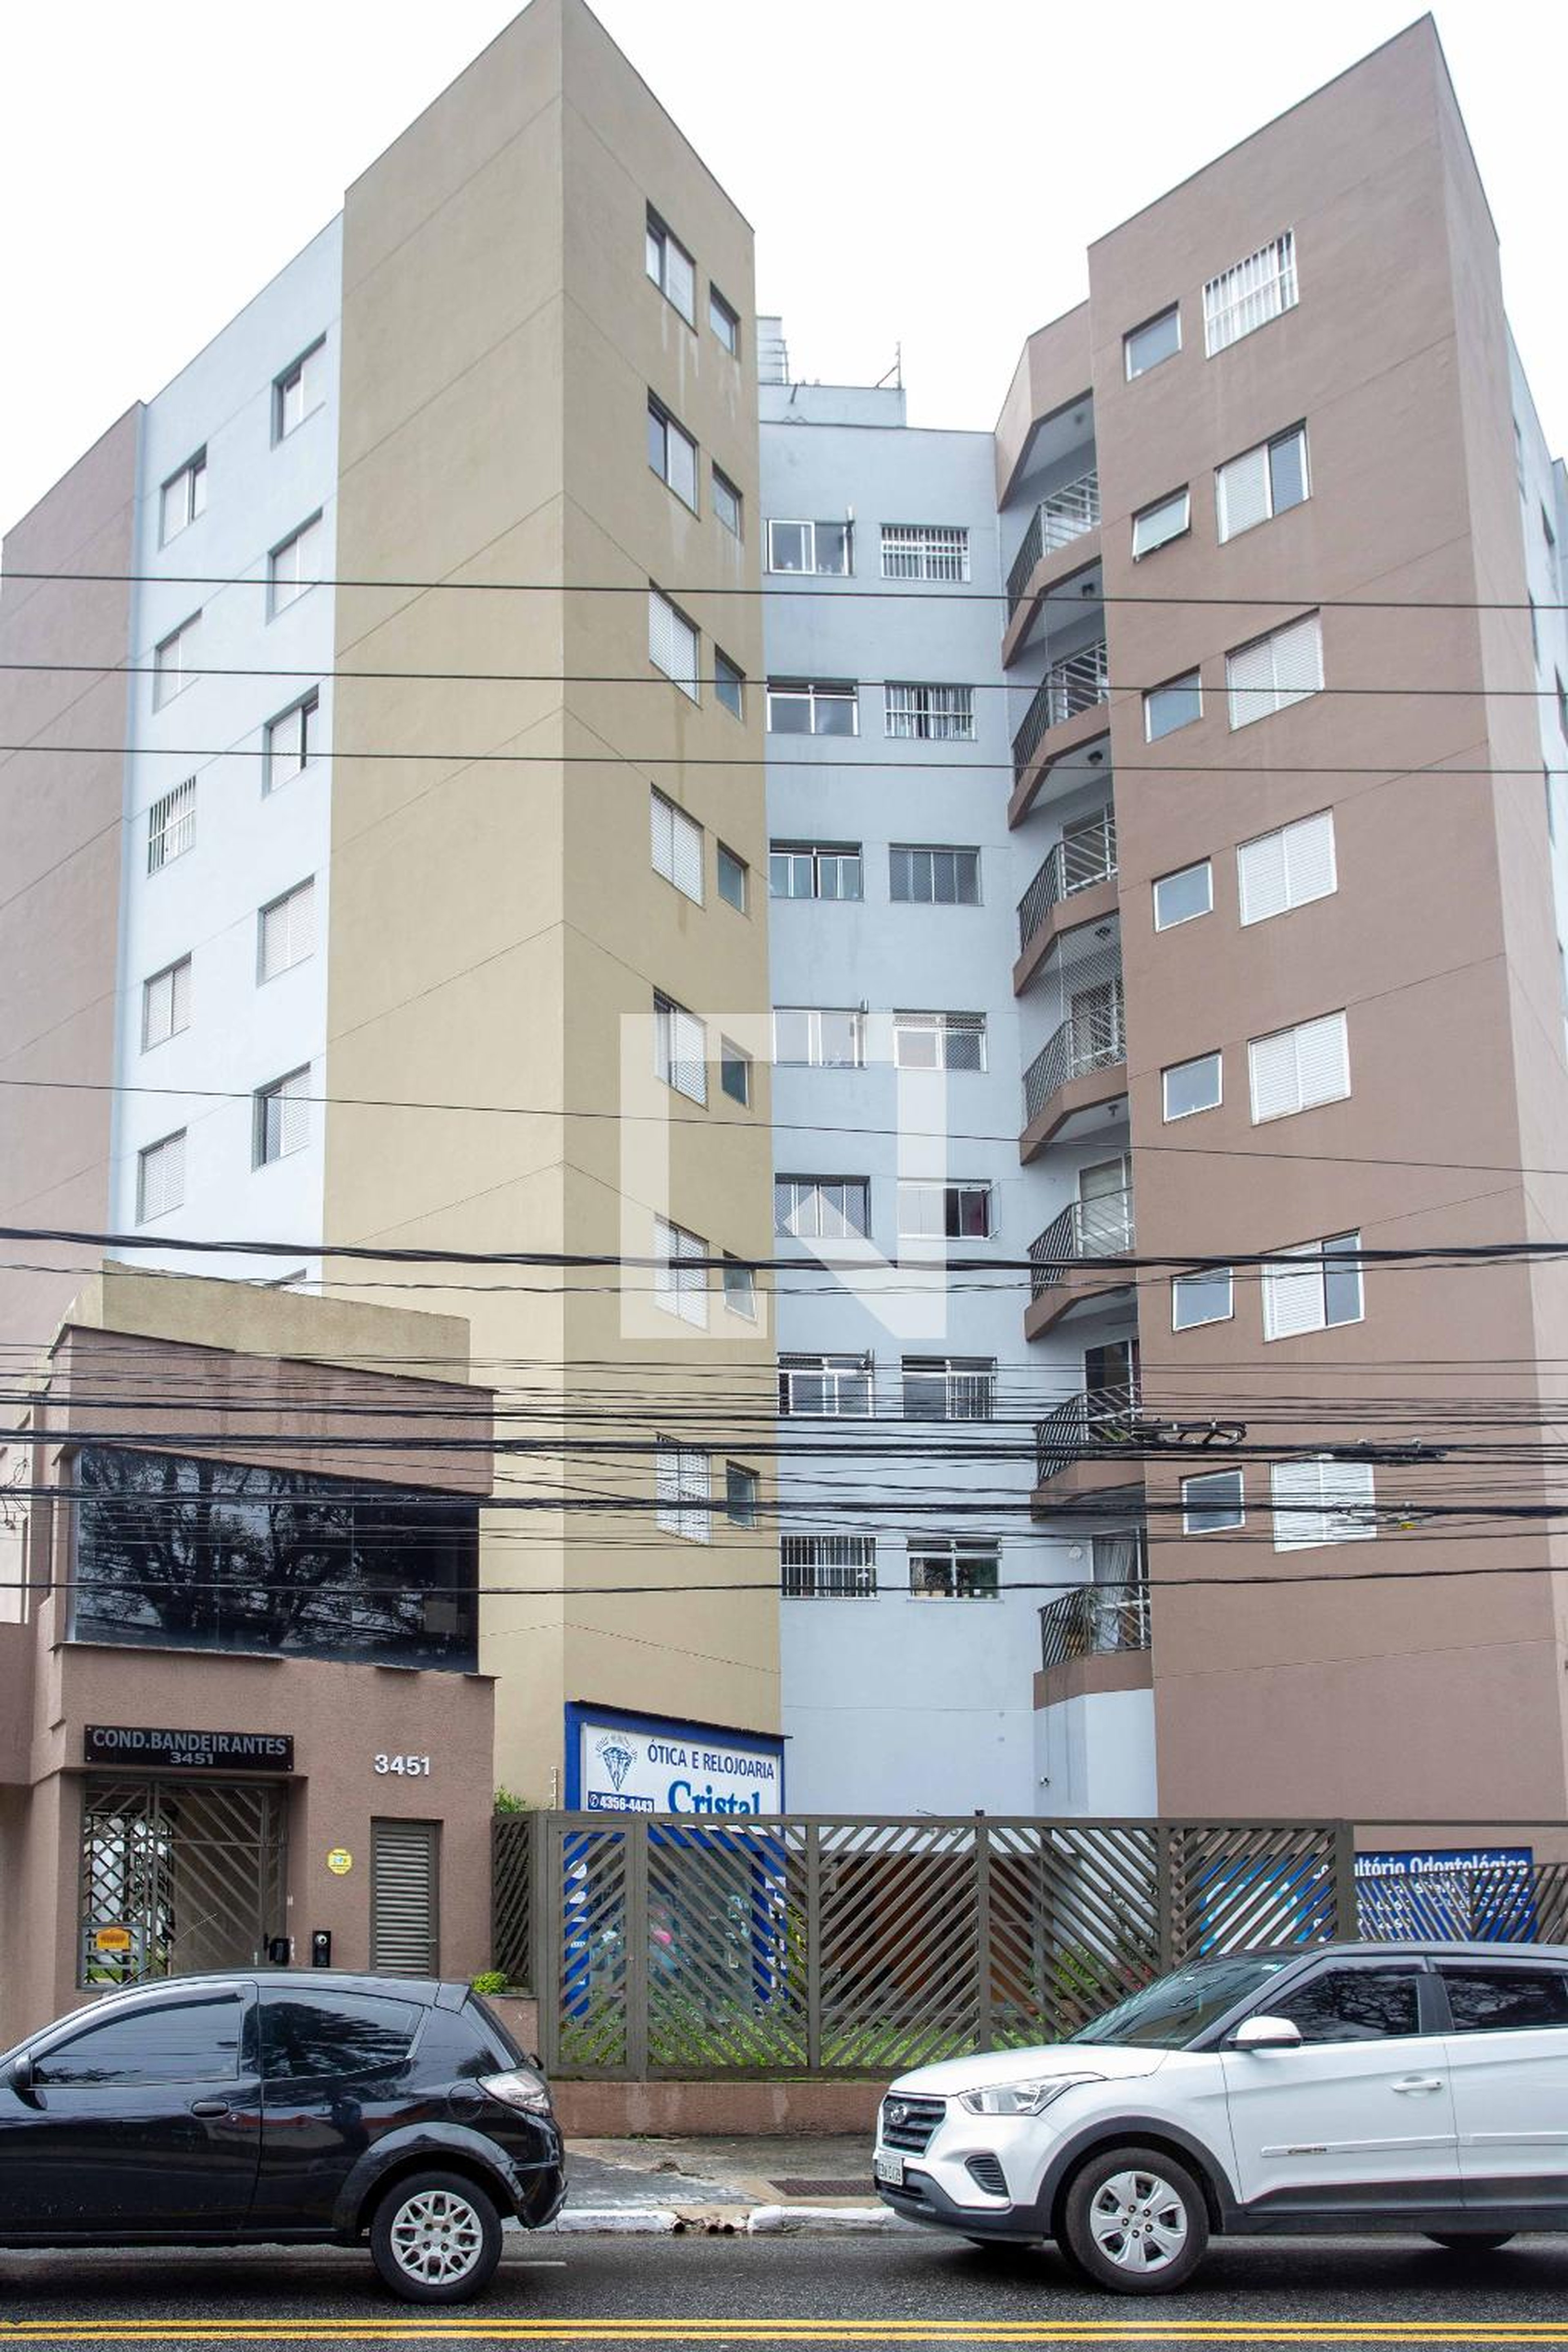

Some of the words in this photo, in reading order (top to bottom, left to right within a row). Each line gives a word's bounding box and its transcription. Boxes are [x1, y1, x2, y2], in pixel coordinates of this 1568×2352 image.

[170, 1752, 214, 1765] 3451
[374, 1754, 429, 1775] 3451
[648, 1739, 687, 1767] ÓTICA
[692, 1751, 699, 1769] E
[703, 1753, 774, 1779] RELOJOARIA
[668, 1780, 760, 1813] Cristal
